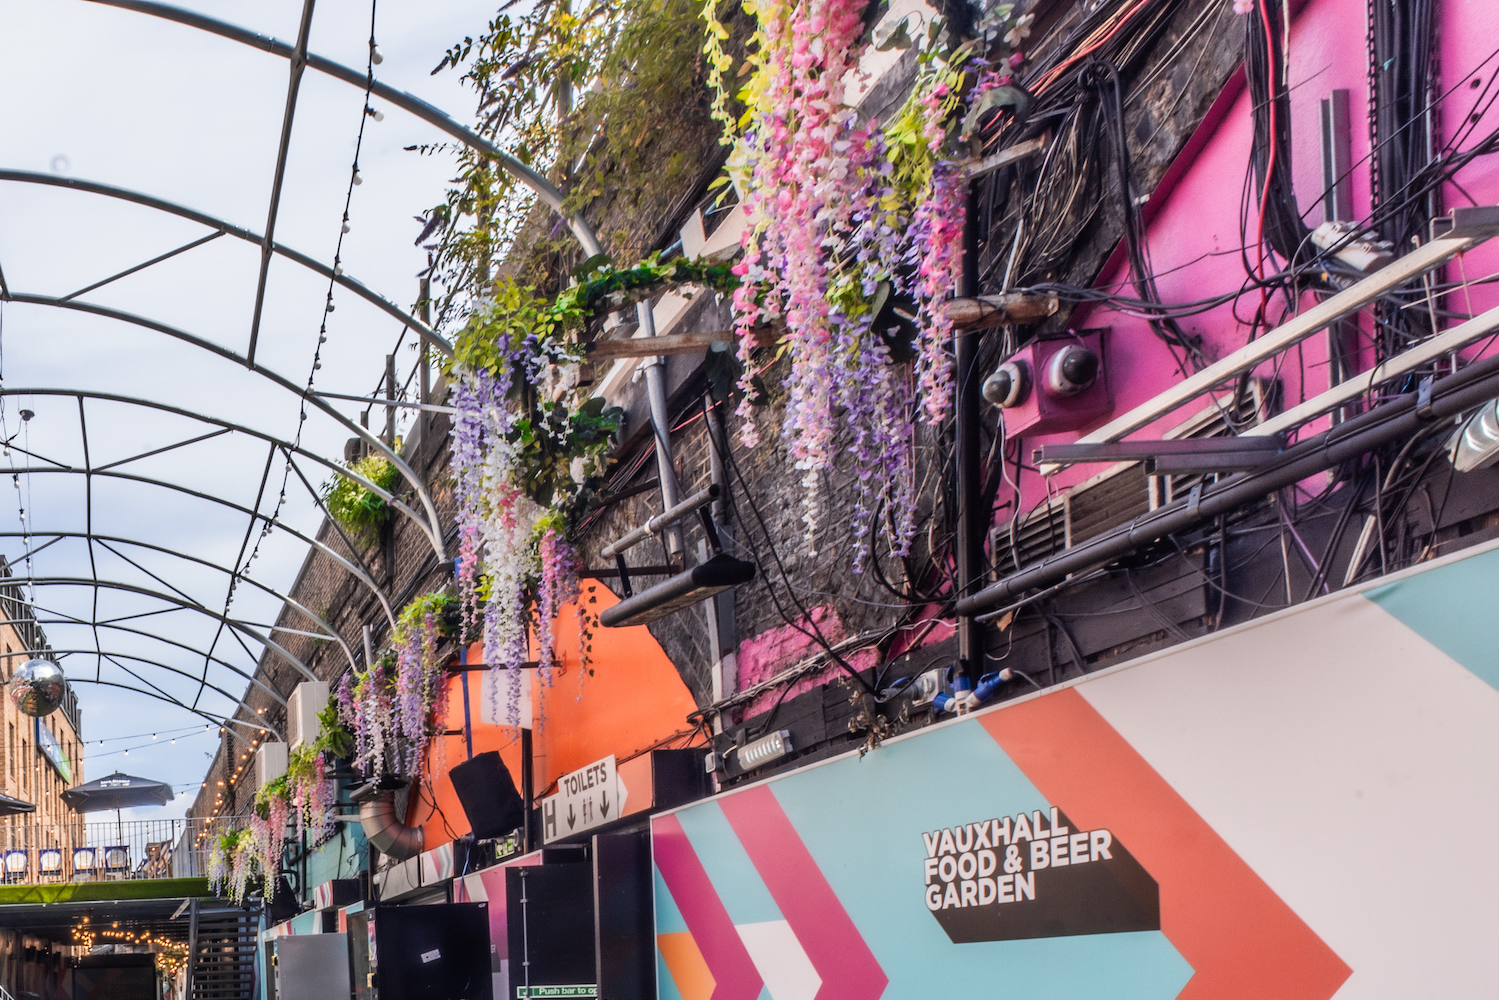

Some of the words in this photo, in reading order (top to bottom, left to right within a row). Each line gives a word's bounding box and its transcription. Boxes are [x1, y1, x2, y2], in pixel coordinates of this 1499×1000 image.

[564, 762, 607, 797] TOILETS
[922, 806, 1069, 859] VAUXHALL
[924, 849, 997, 885] FOOD
[1003, 844, 1023, 873] &
[1030, 829, 1113, 871] BEER
[925, 871, 1036, 911] GARDEN
